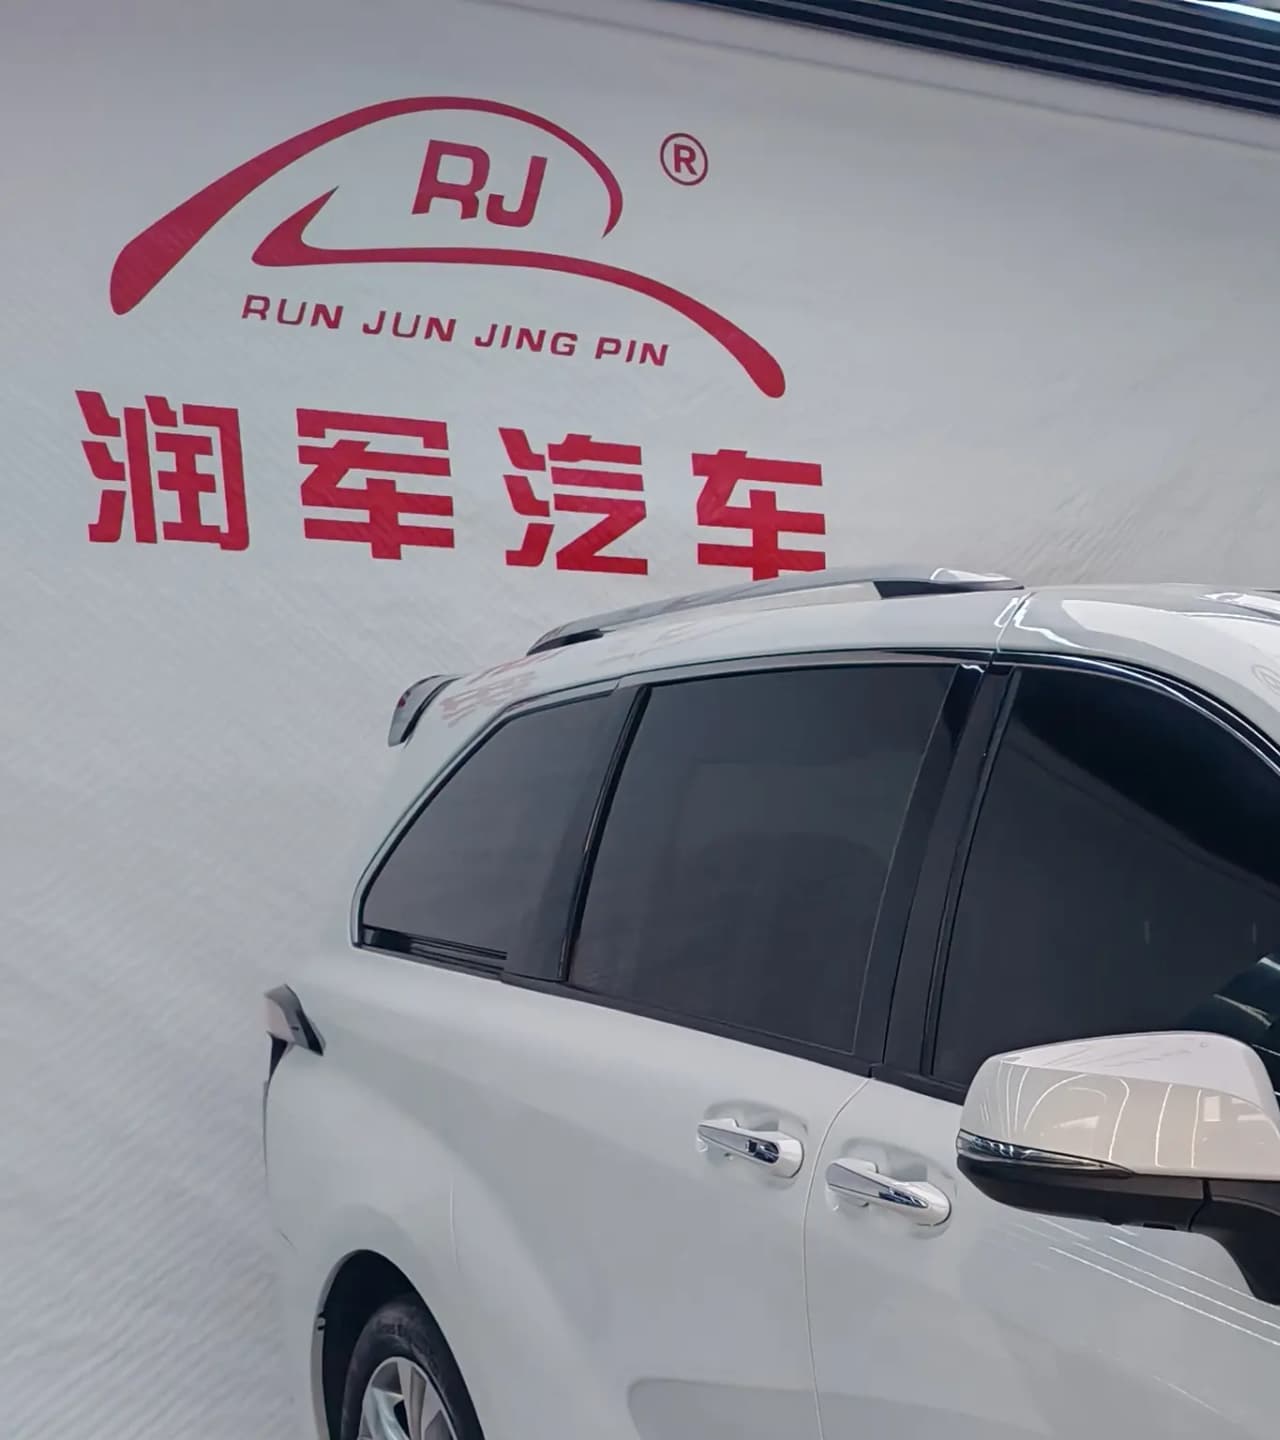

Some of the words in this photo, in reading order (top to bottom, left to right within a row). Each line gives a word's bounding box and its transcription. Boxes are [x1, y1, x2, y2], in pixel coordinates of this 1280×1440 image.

[411, 139, 548, 228] RJ
[241, 294, 344, 330] RUN
[362, 310, 457, 343] JUN
[474, 323, 578, 357] JING
[595, 336, 669, 368] PIN
[75, 389, 827, 582] 润军汽车
